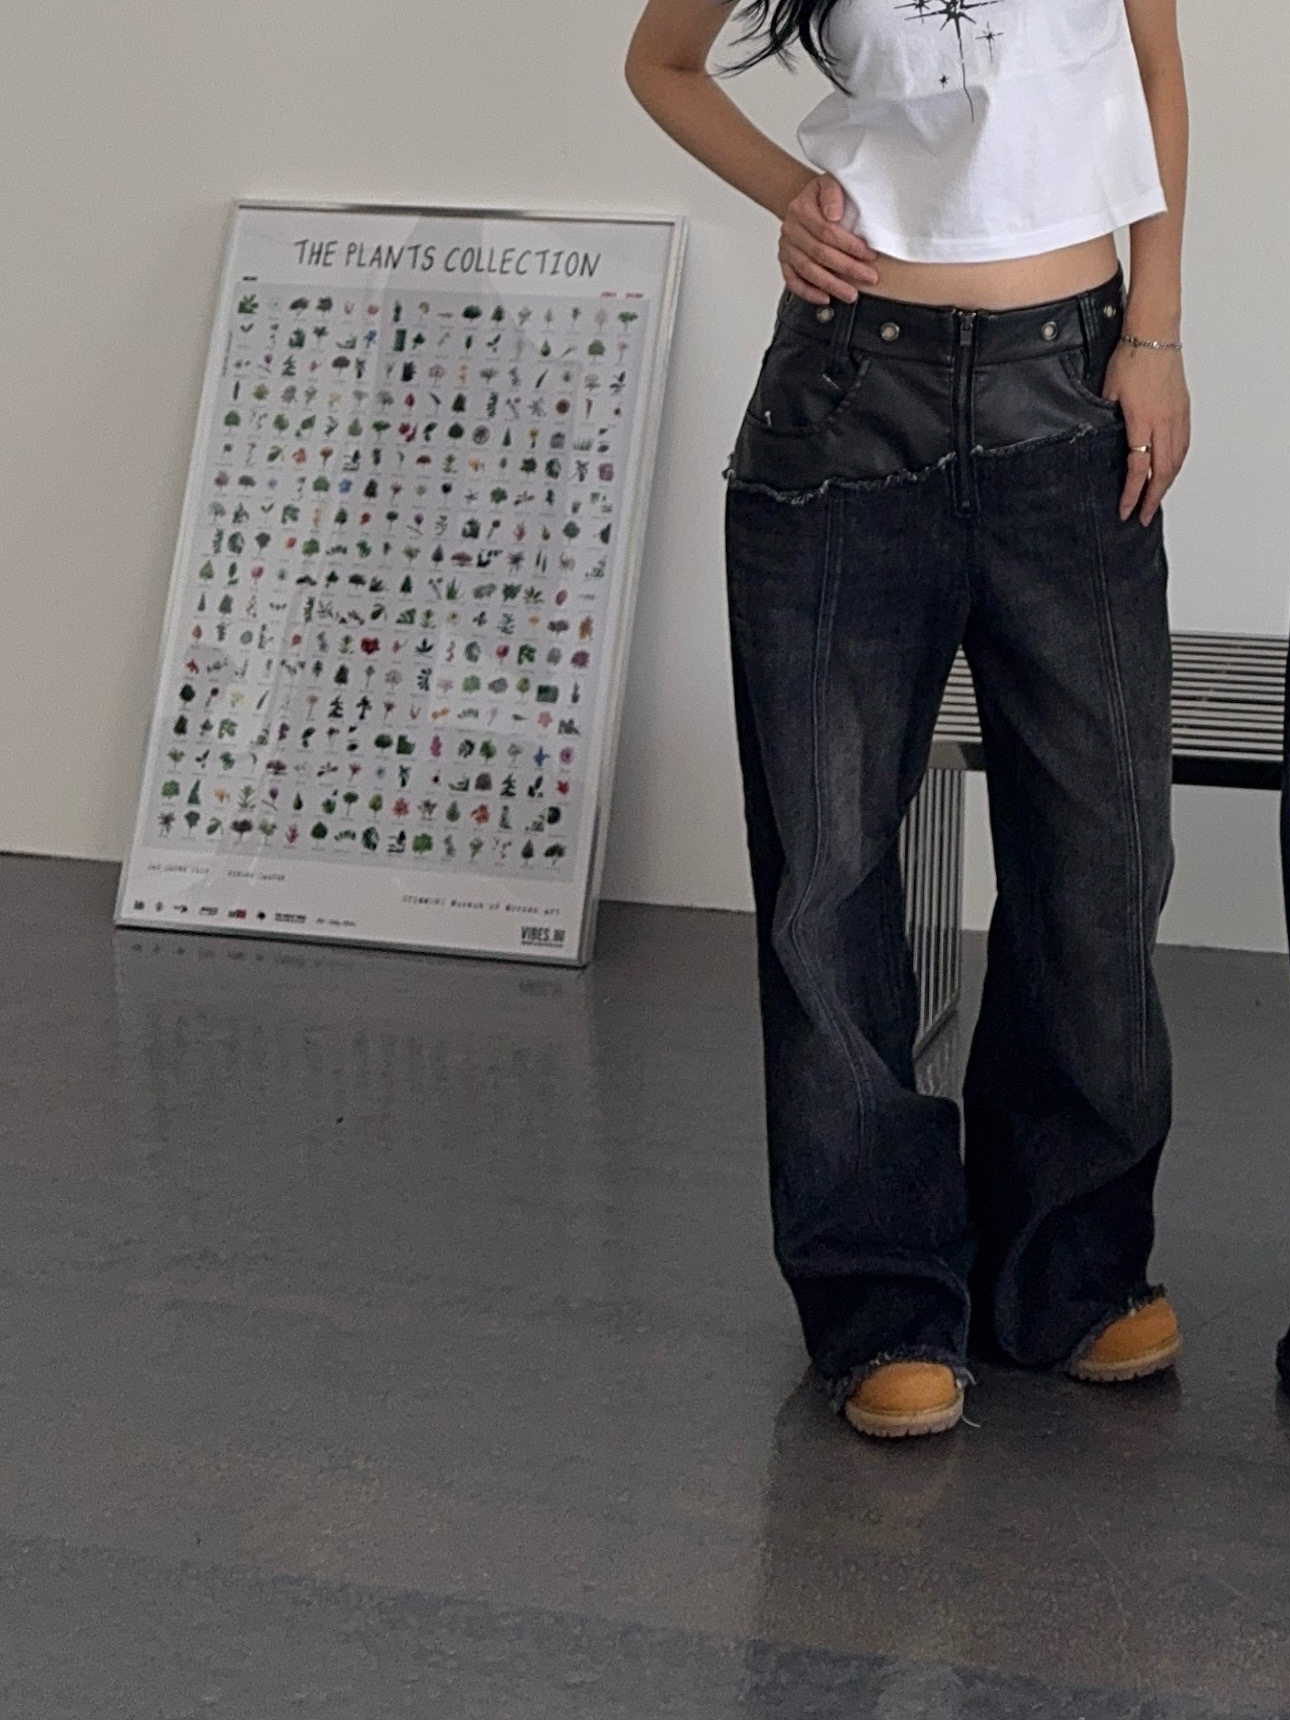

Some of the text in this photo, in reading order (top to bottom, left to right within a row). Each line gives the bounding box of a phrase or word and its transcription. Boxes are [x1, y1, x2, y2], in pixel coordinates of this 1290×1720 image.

[294, 238, 602, 278] THE PLANTS COLLECTION
